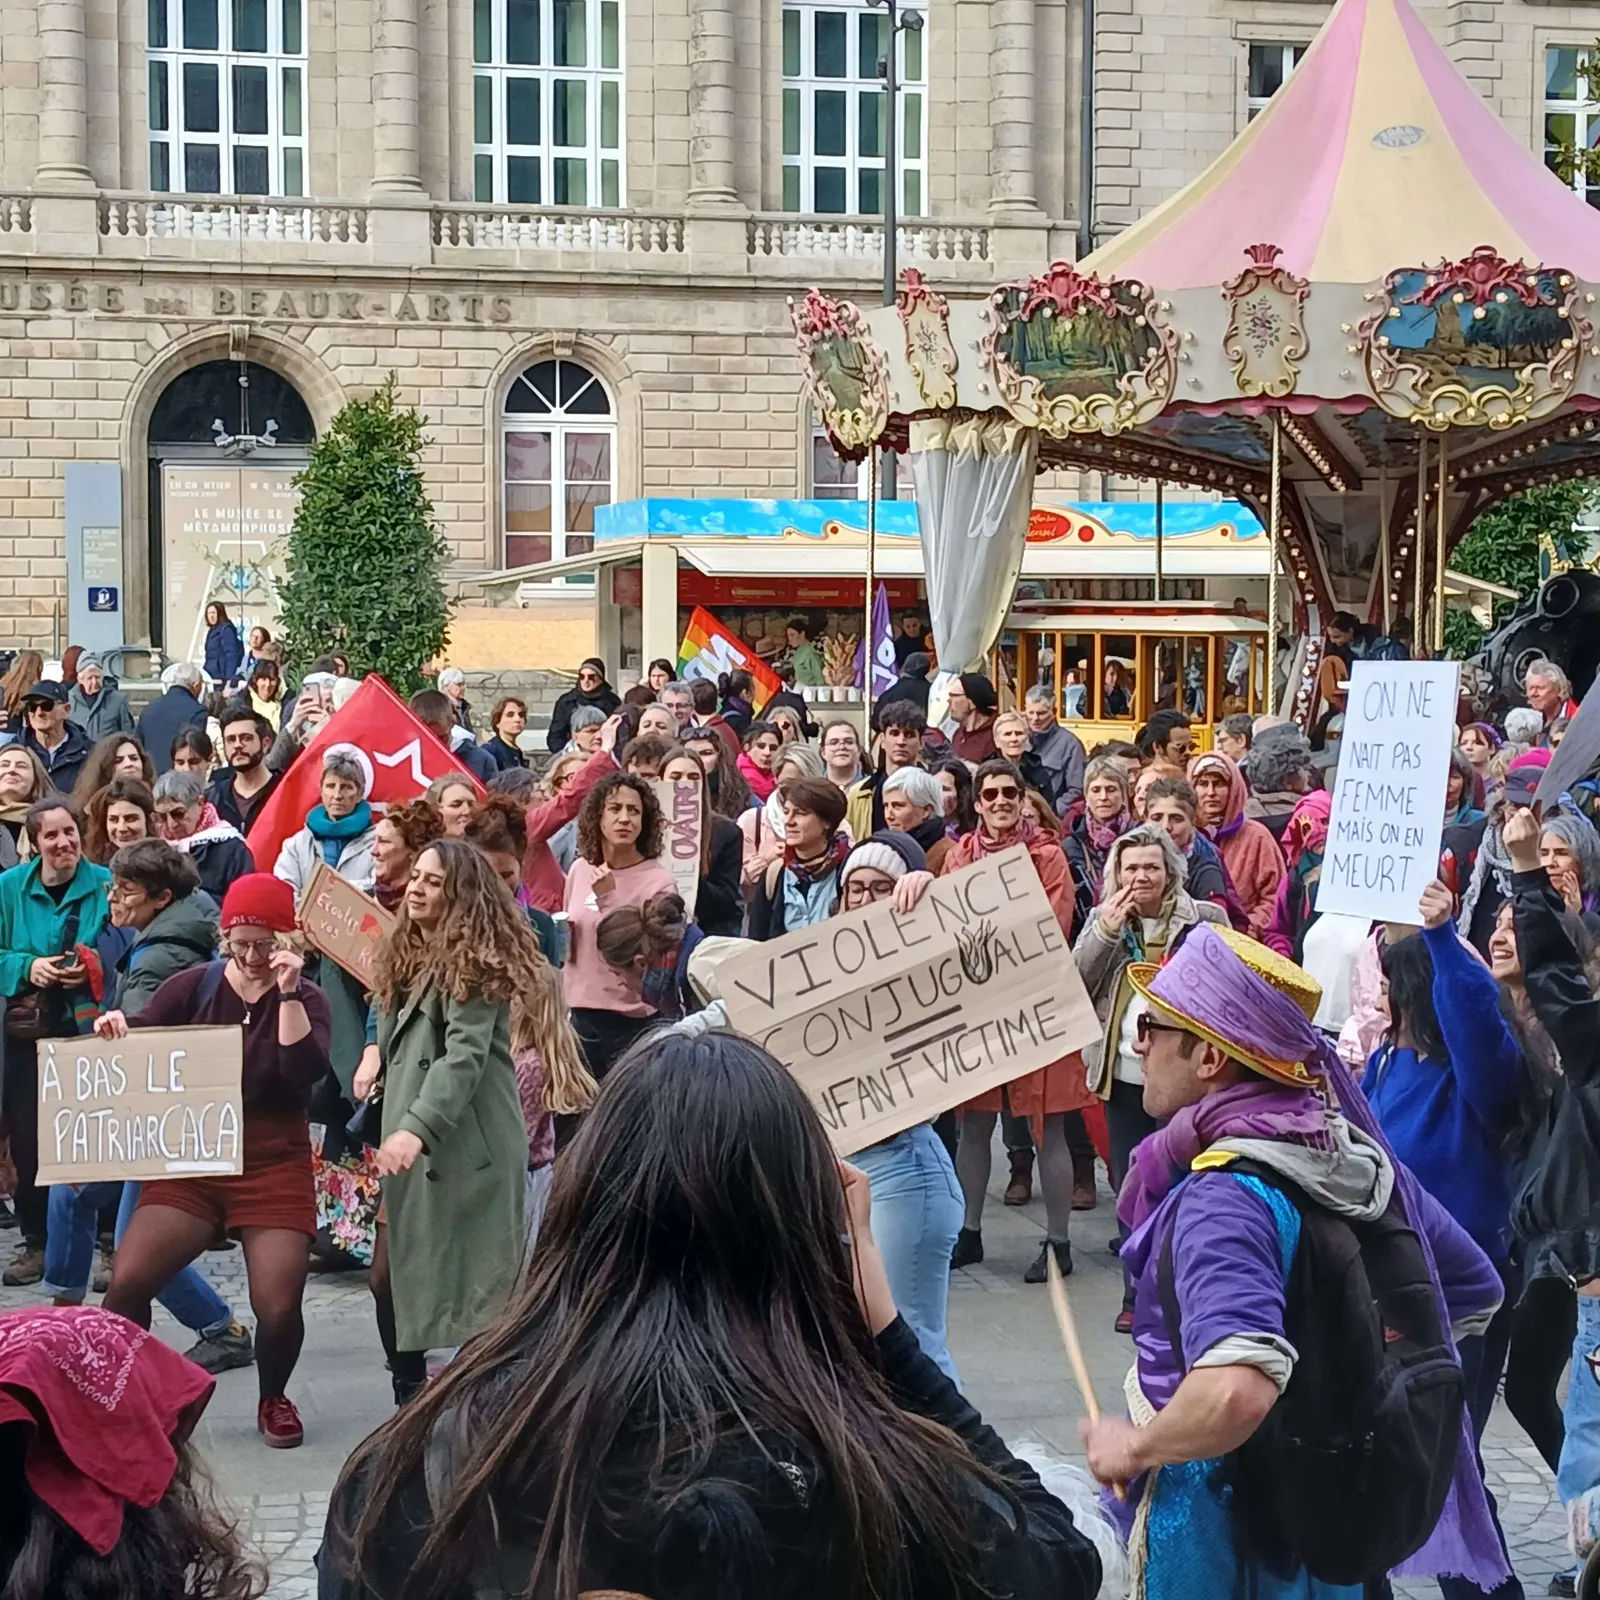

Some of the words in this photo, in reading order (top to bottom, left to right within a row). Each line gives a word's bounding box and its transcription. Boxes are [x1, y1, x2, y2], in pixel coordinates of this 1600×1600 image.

[211, 286, 512, 323] BEAUX-ARTS
[194, 508, 209, 519] LE
[216, 507, 260, 520] MUSÉE
[1363, 681, 1397, 721] ON
[1407, 680, 1434, 718] NE
[1349, 741, 1384, 770] NAIT
[1392, 741, 1421, 770] PAS
[1339, 778, 1418, 816] FEMME
[1380, 822, 1400, 844] ON
[1404, 827, 1424, 847] EN
[1331, 853, 1414, 893] MEURT
[734, 854, 1030, 1010] VIOLENCE
[42, 1042, 63, 1104] À
[76, 1054, 127, 1102] BAS
[147, 1049, 187, 1093] LE
[817, 1056, 915, 1131] NFANT
[922, 996, 1067, 1084] VICTIME
